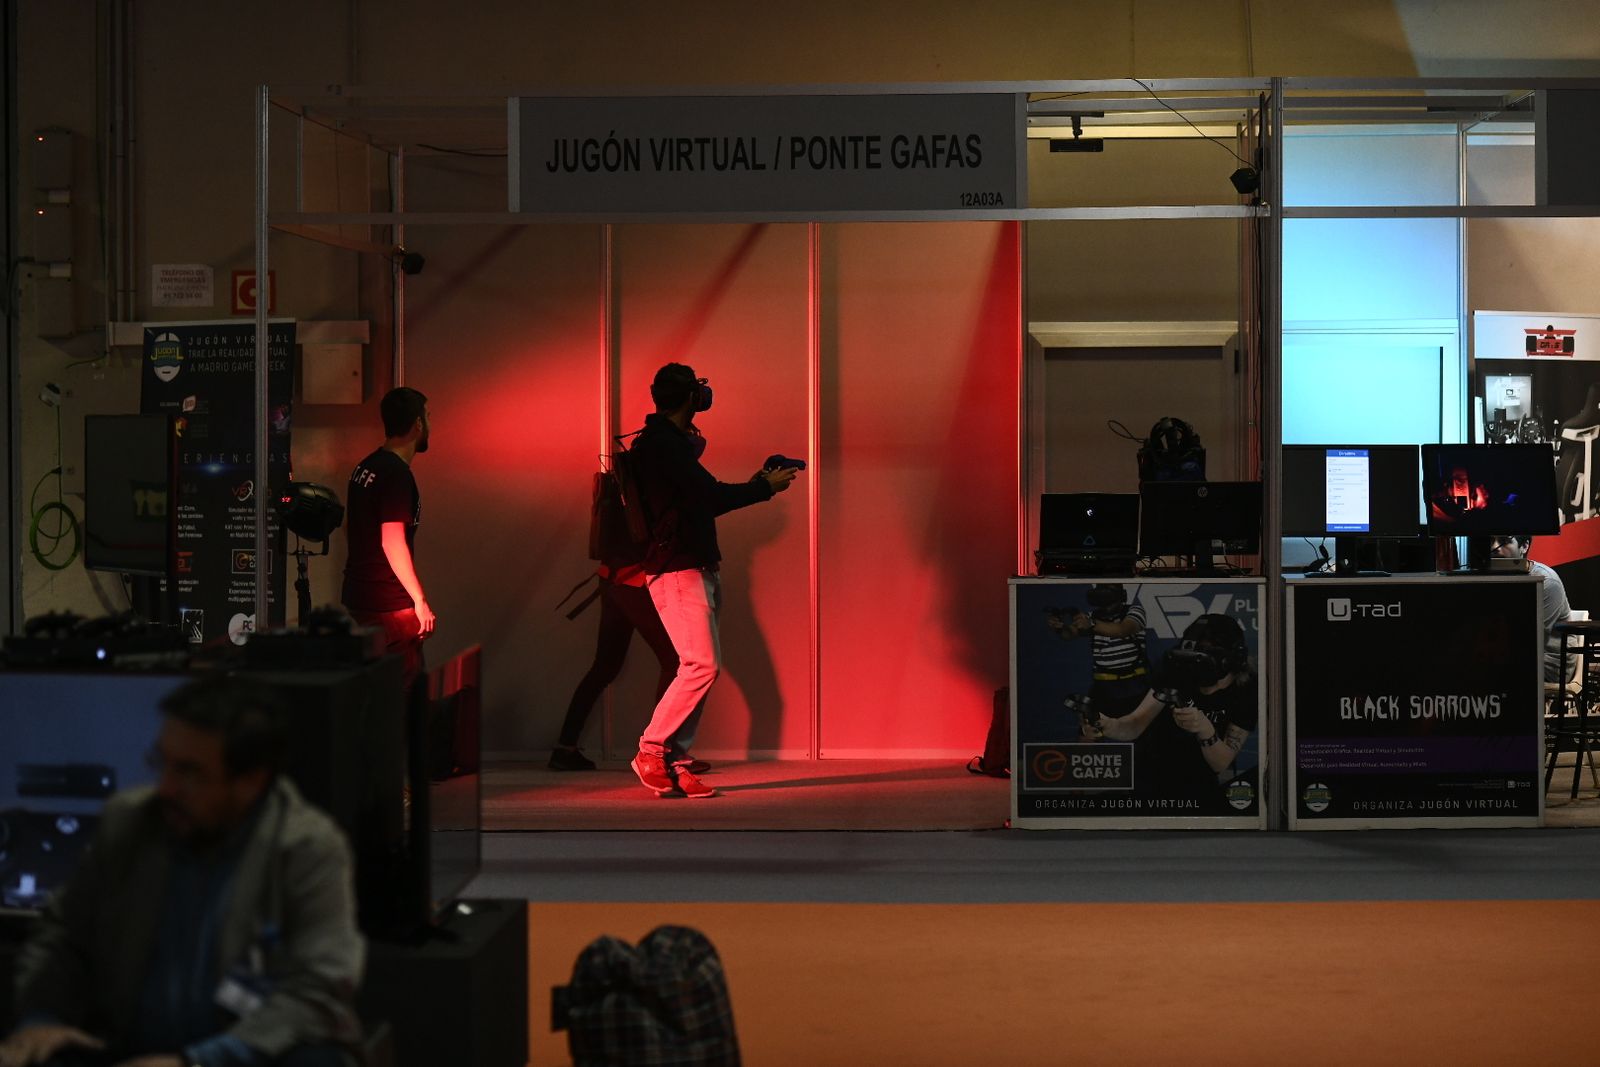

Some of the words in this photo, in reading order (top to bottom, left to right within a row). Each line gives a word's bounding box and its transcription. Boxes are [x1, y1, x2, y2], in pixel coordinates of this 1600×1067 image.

[546, 130, 640, 172] JUGÓN
[650, 136, 766, 171] VIRTUAL
[774, 136, 782, 171] /
[791, 135, 882, 169] PONTE
[891, 133, 983, 169] GAFAS
[959, 192, 1004, 207] 12A03A
[188, 334, 227, 346] JUGÓN
[236, 334, 288, 344] VIRUAL
[188, 348, 206, 359] TRAE
[207, 348, 217, 359] LA
[190, 363, 196, 373] A
[198, 361, 229, 373] MADRID
[1340, 695, 1400, 722] BLACK
[1071, 754, 1122, 767] PONTE
[1072, 767, 1121, 779] GAFAS
[1035, 799, 1096, 809] ORGANIZA
[1101, 797, 1143, 809] JUGÓN
[1148, 798, 1200, 808] VIRTUAL
[1353, 800, 1414, 810] ORGANIZA
[1420, 798, 1461, 809] JUGÓN
[1466, 798, 1519, 809] VIRTUAL
